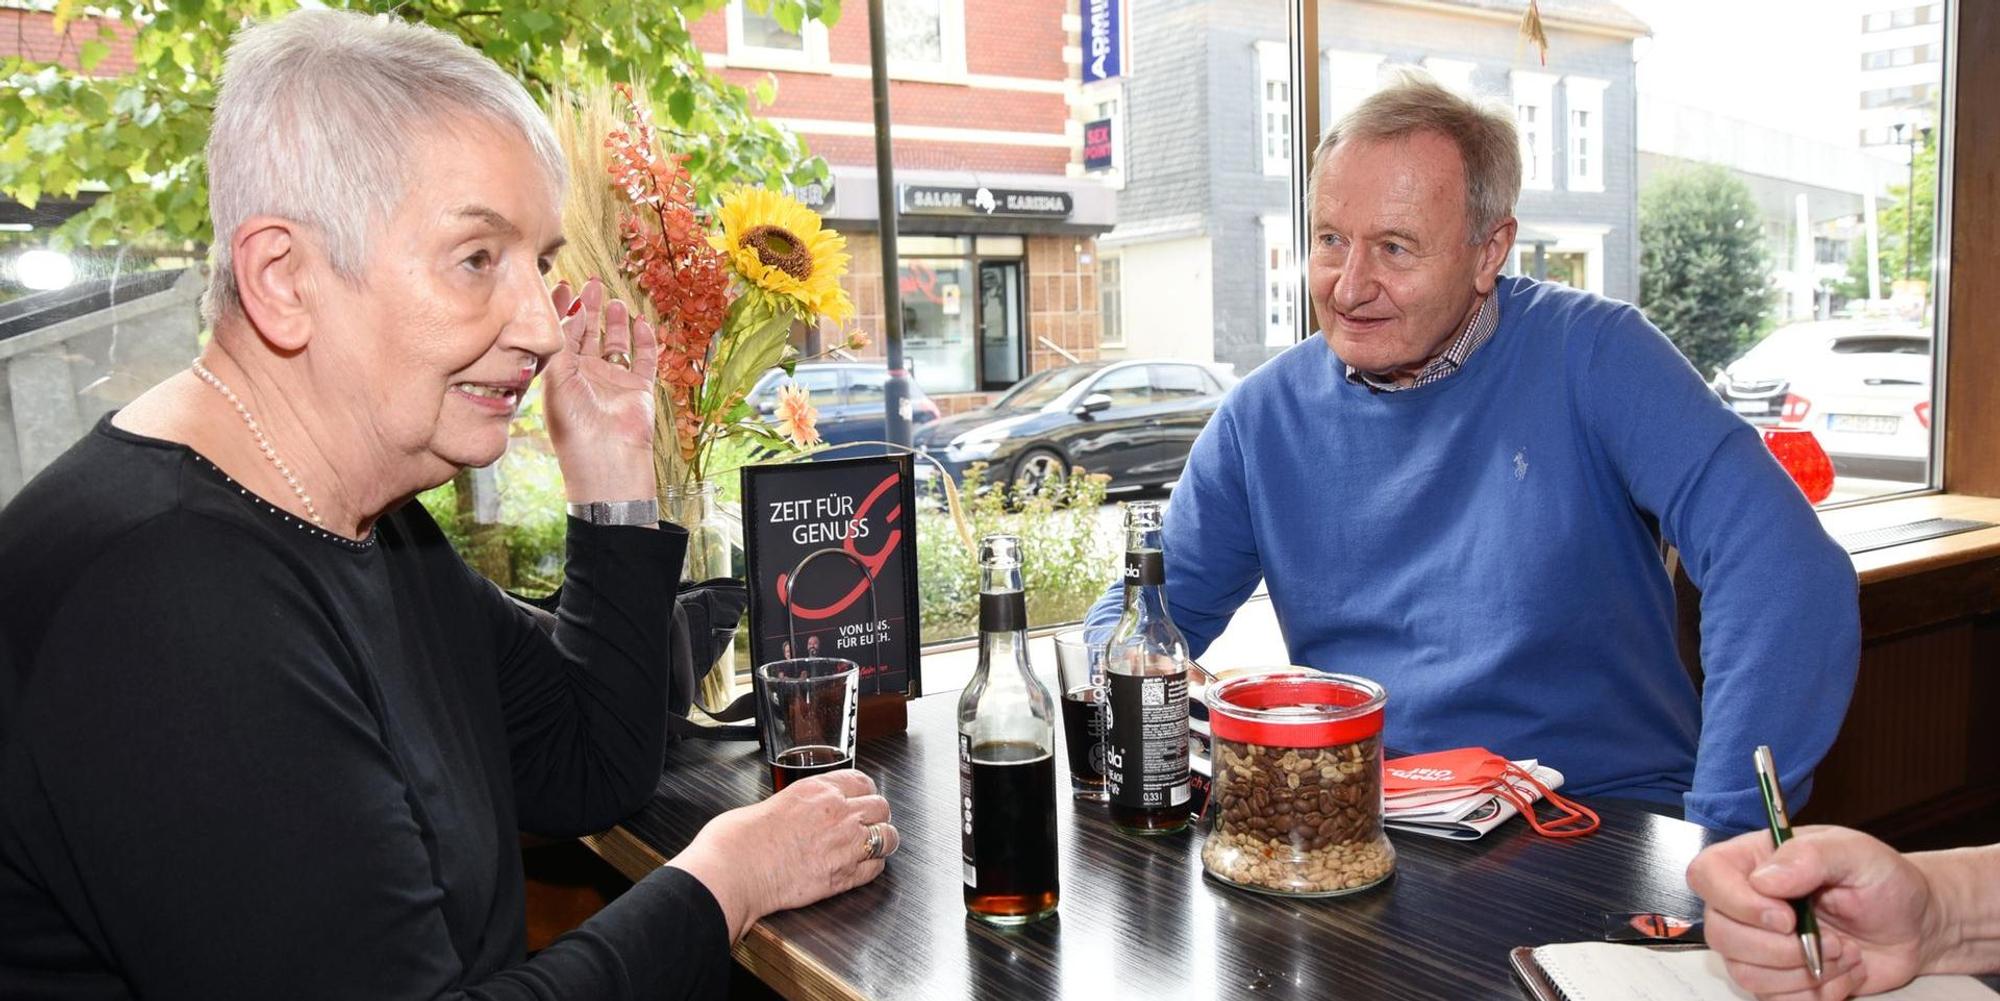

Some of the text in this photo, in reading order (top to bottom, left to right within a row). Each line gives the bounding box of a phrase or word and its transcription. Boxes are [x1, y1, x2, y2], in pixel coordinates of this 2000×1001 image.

[1087, 127, 1109, 144] SEX
[914, 191, 963, 208] SALON
[769, 492, 855, 523] ZEIT FÜR
[792, 518, 870, 545] GENUSS
[838, 623, 863, 637] VON
[837, 631, 891, 650] FÜR EUH.
